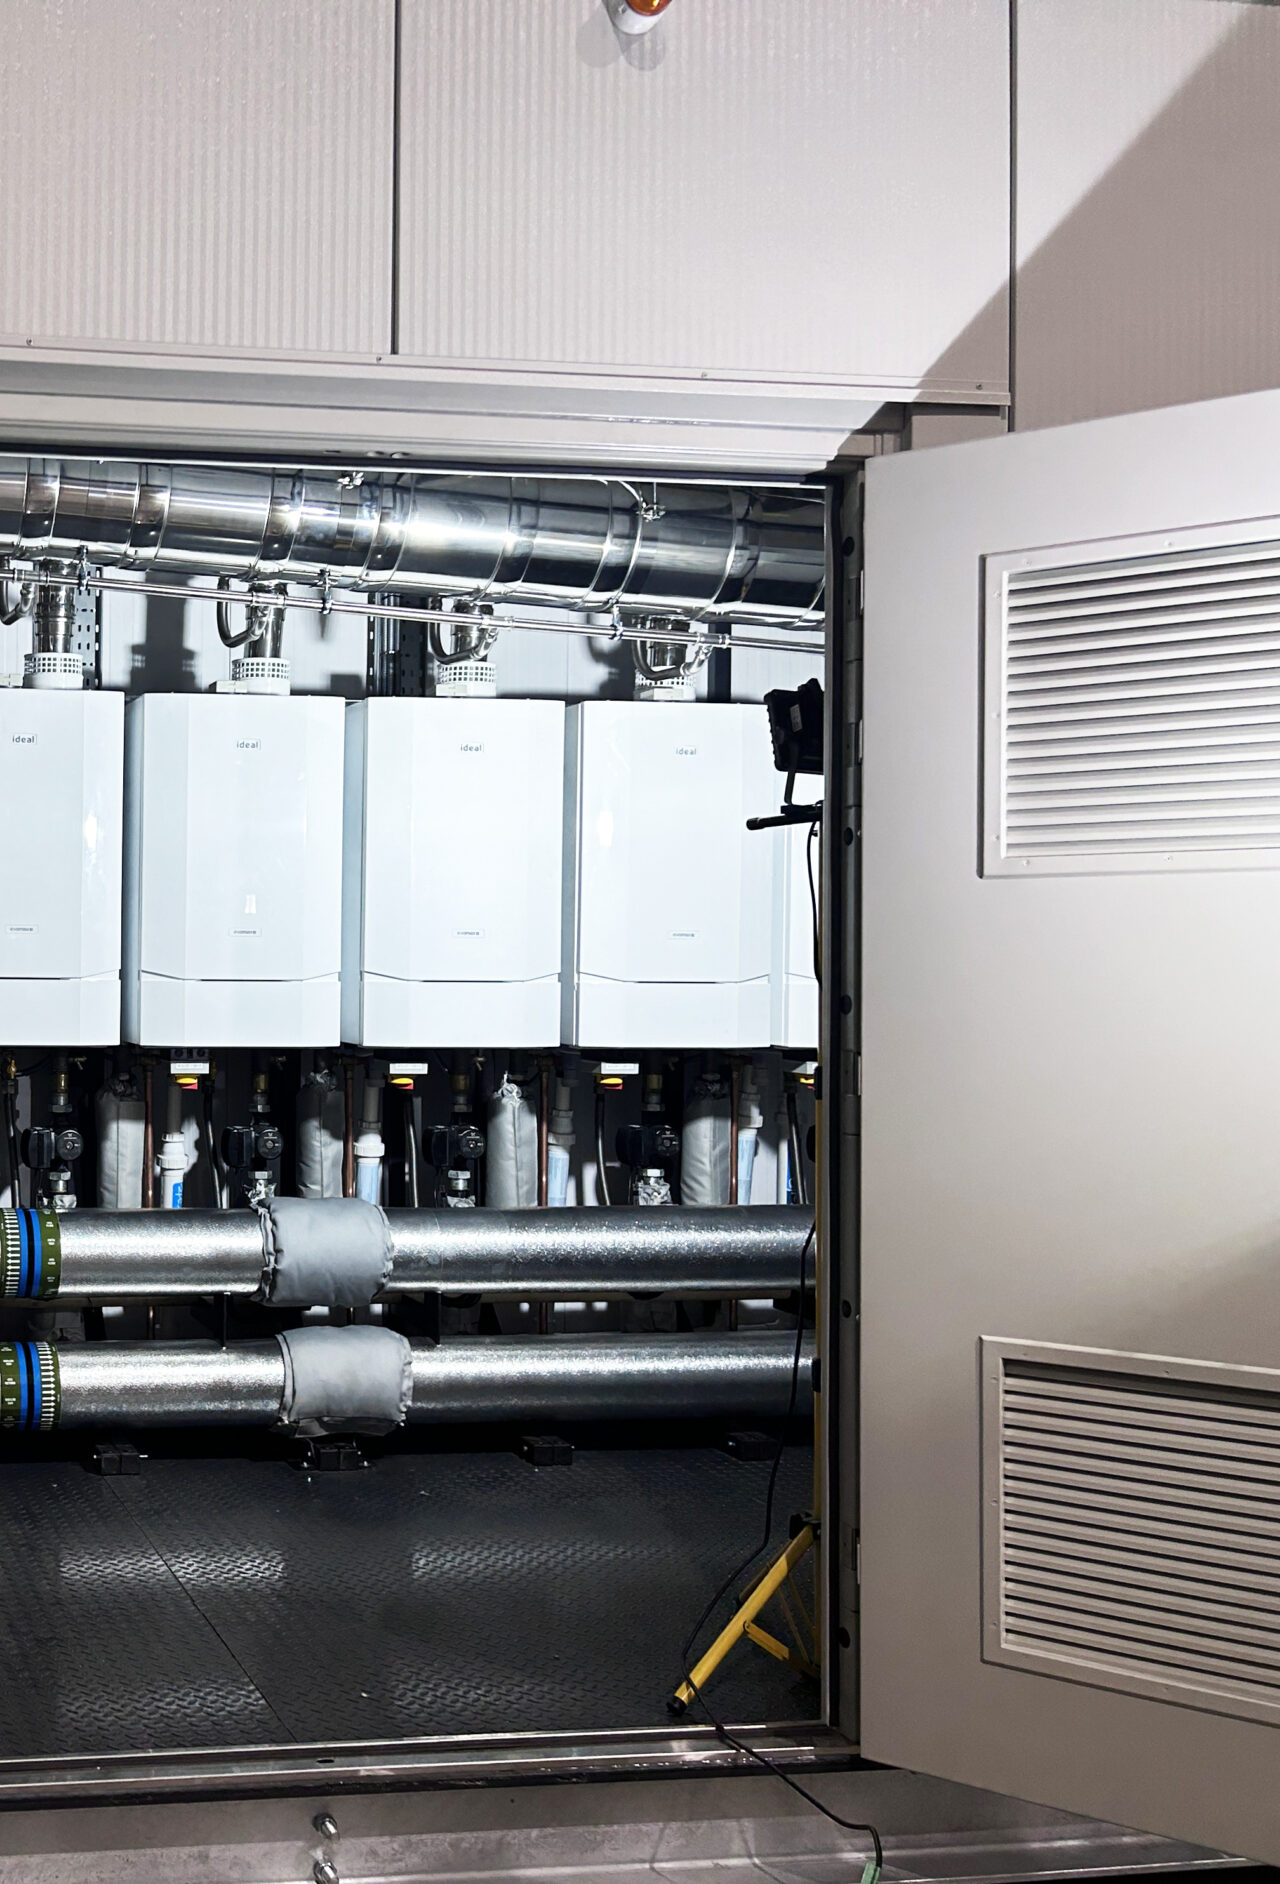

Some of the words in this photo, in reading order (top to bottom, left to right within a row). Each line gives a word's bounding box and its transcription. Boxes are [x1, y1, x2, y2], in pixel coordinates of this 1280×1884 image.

[12, 735, 35, 744] ideal
[236, 740, 259, 749] ideal
[460, 743, 482, 752] ideal
[675, 747, 697, 755] ideal
